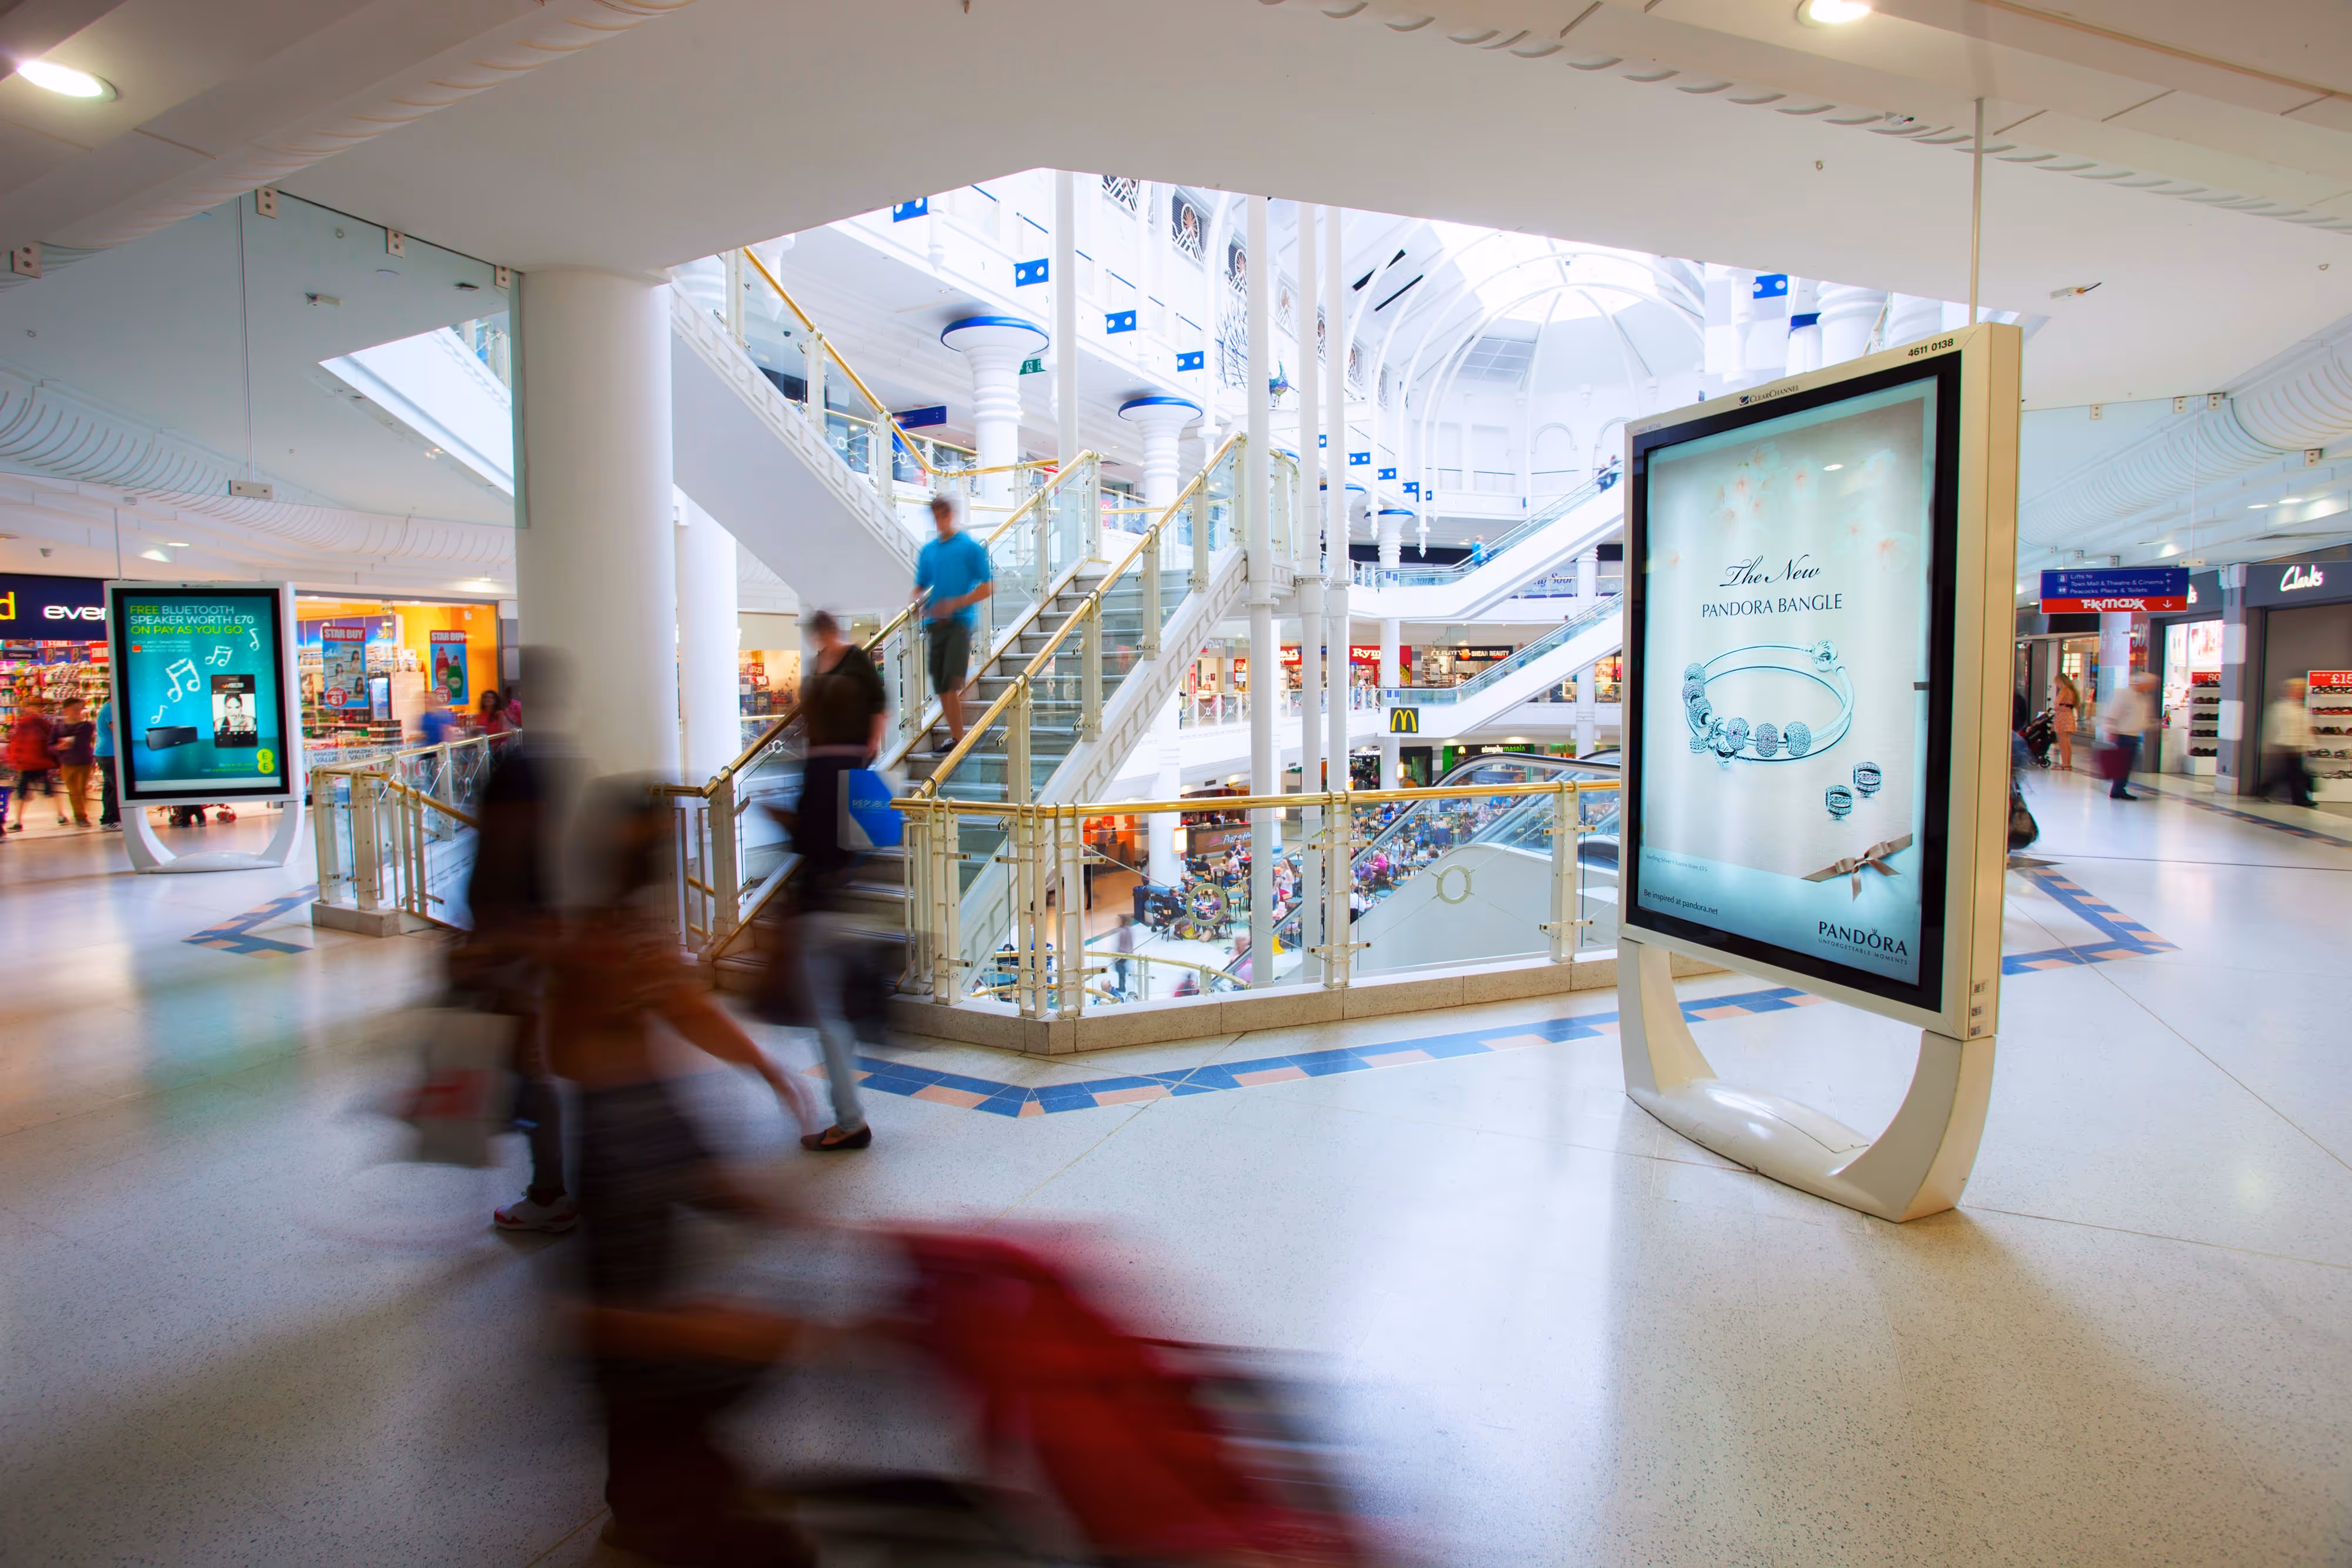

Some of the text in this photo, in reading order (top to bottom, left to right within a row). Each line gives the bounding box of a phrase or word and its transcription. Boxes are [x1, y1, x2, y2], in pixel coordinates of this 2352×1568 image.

[1908, 338, 1953, 356] 4611 0138
[1719, 554, 1820, 587] The New
[2280, 564, 2323, 591] Clarks
[130, 606, 235, 614] FREE BLUETOOTH
[1702, 593, 1842, 618] PANDORA BANGLE
[131, 615, 254, 624] SPEAKER WORTH £70
[131, 625, 150, 634] ON
[153, 625, 176, 634] PAY
[176, 625, 193, 634] AS
[195, 625, 220, 634] YOU
[325, 628, 363, 640] STAR BUY
[431, 632, 465, 641] STAR BUY
[1652, 891, 1674, 903] inspired
[1682, 901, 1718, 915] pandora.net
[1818, 921, 1907, 956] PANDORA
[1818, 938, 1870, 956] UNFORGETTABLE
